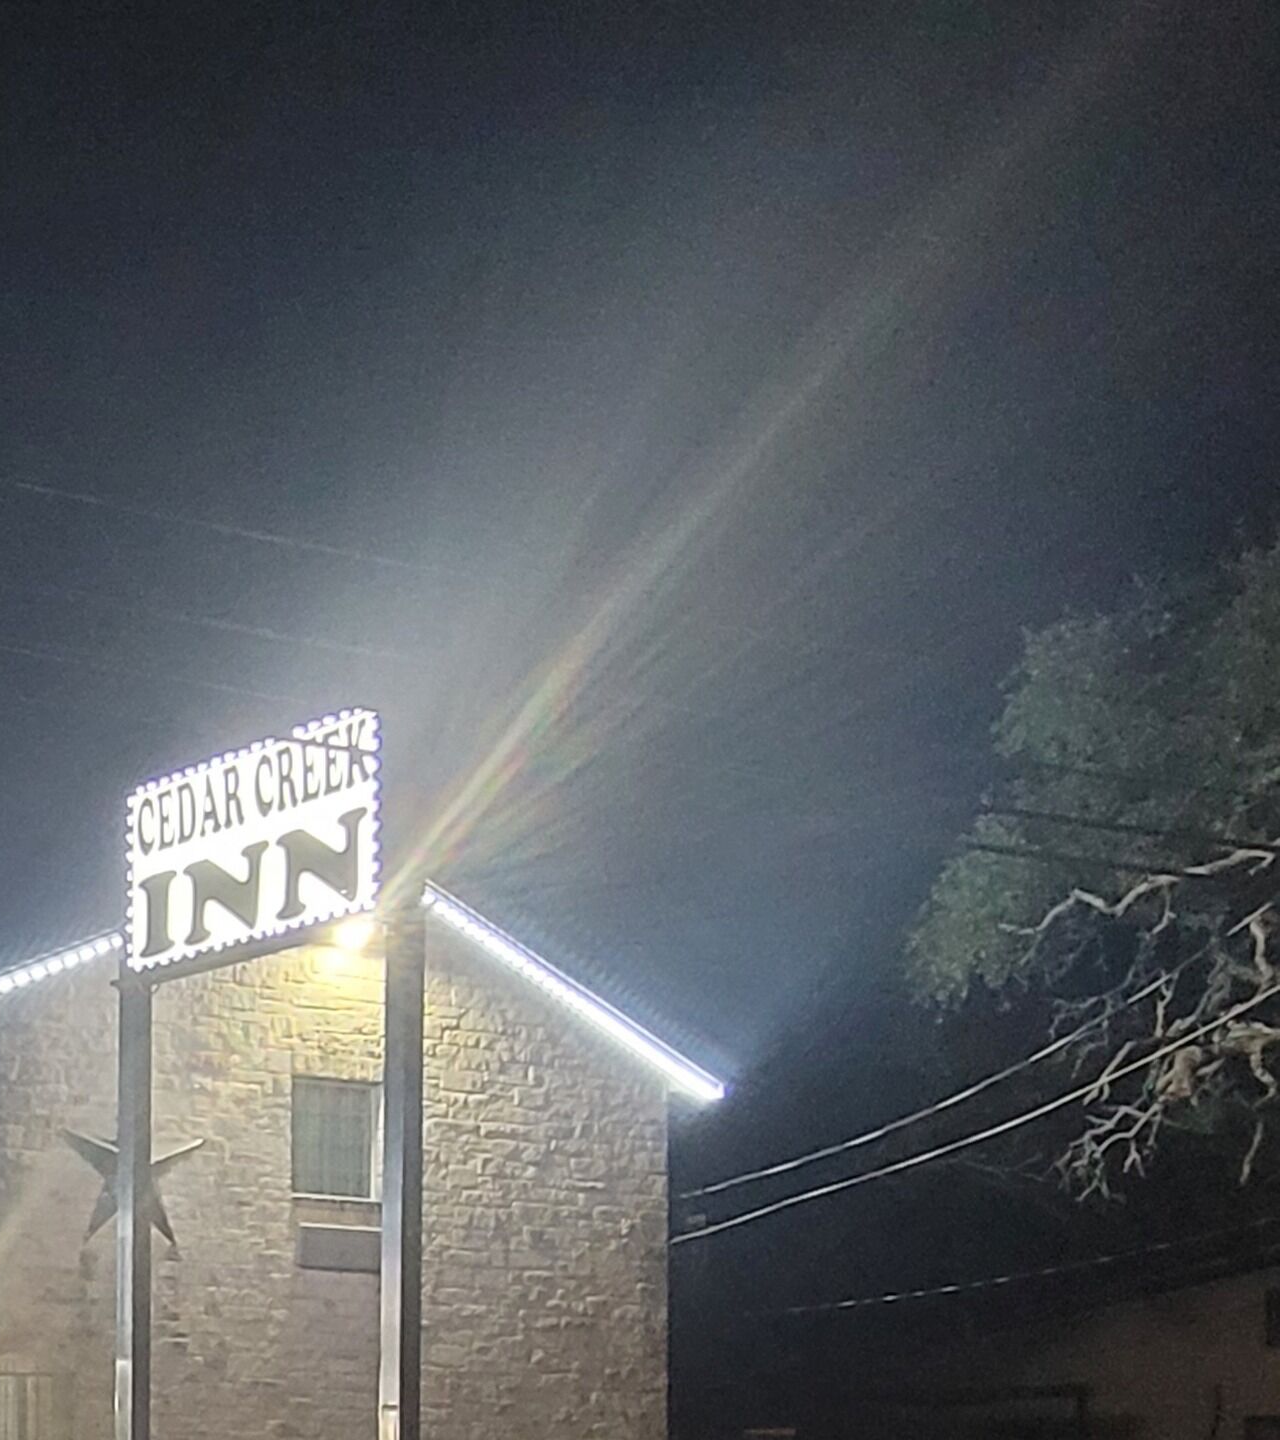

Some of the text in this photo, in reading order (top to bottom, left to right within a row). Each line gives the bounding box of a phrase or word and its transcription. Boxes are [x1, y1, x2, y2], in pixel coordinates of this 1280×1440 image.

[138, 717, 370, 856] CEDAR CREEK
[139, 807, 369, 957] INN
